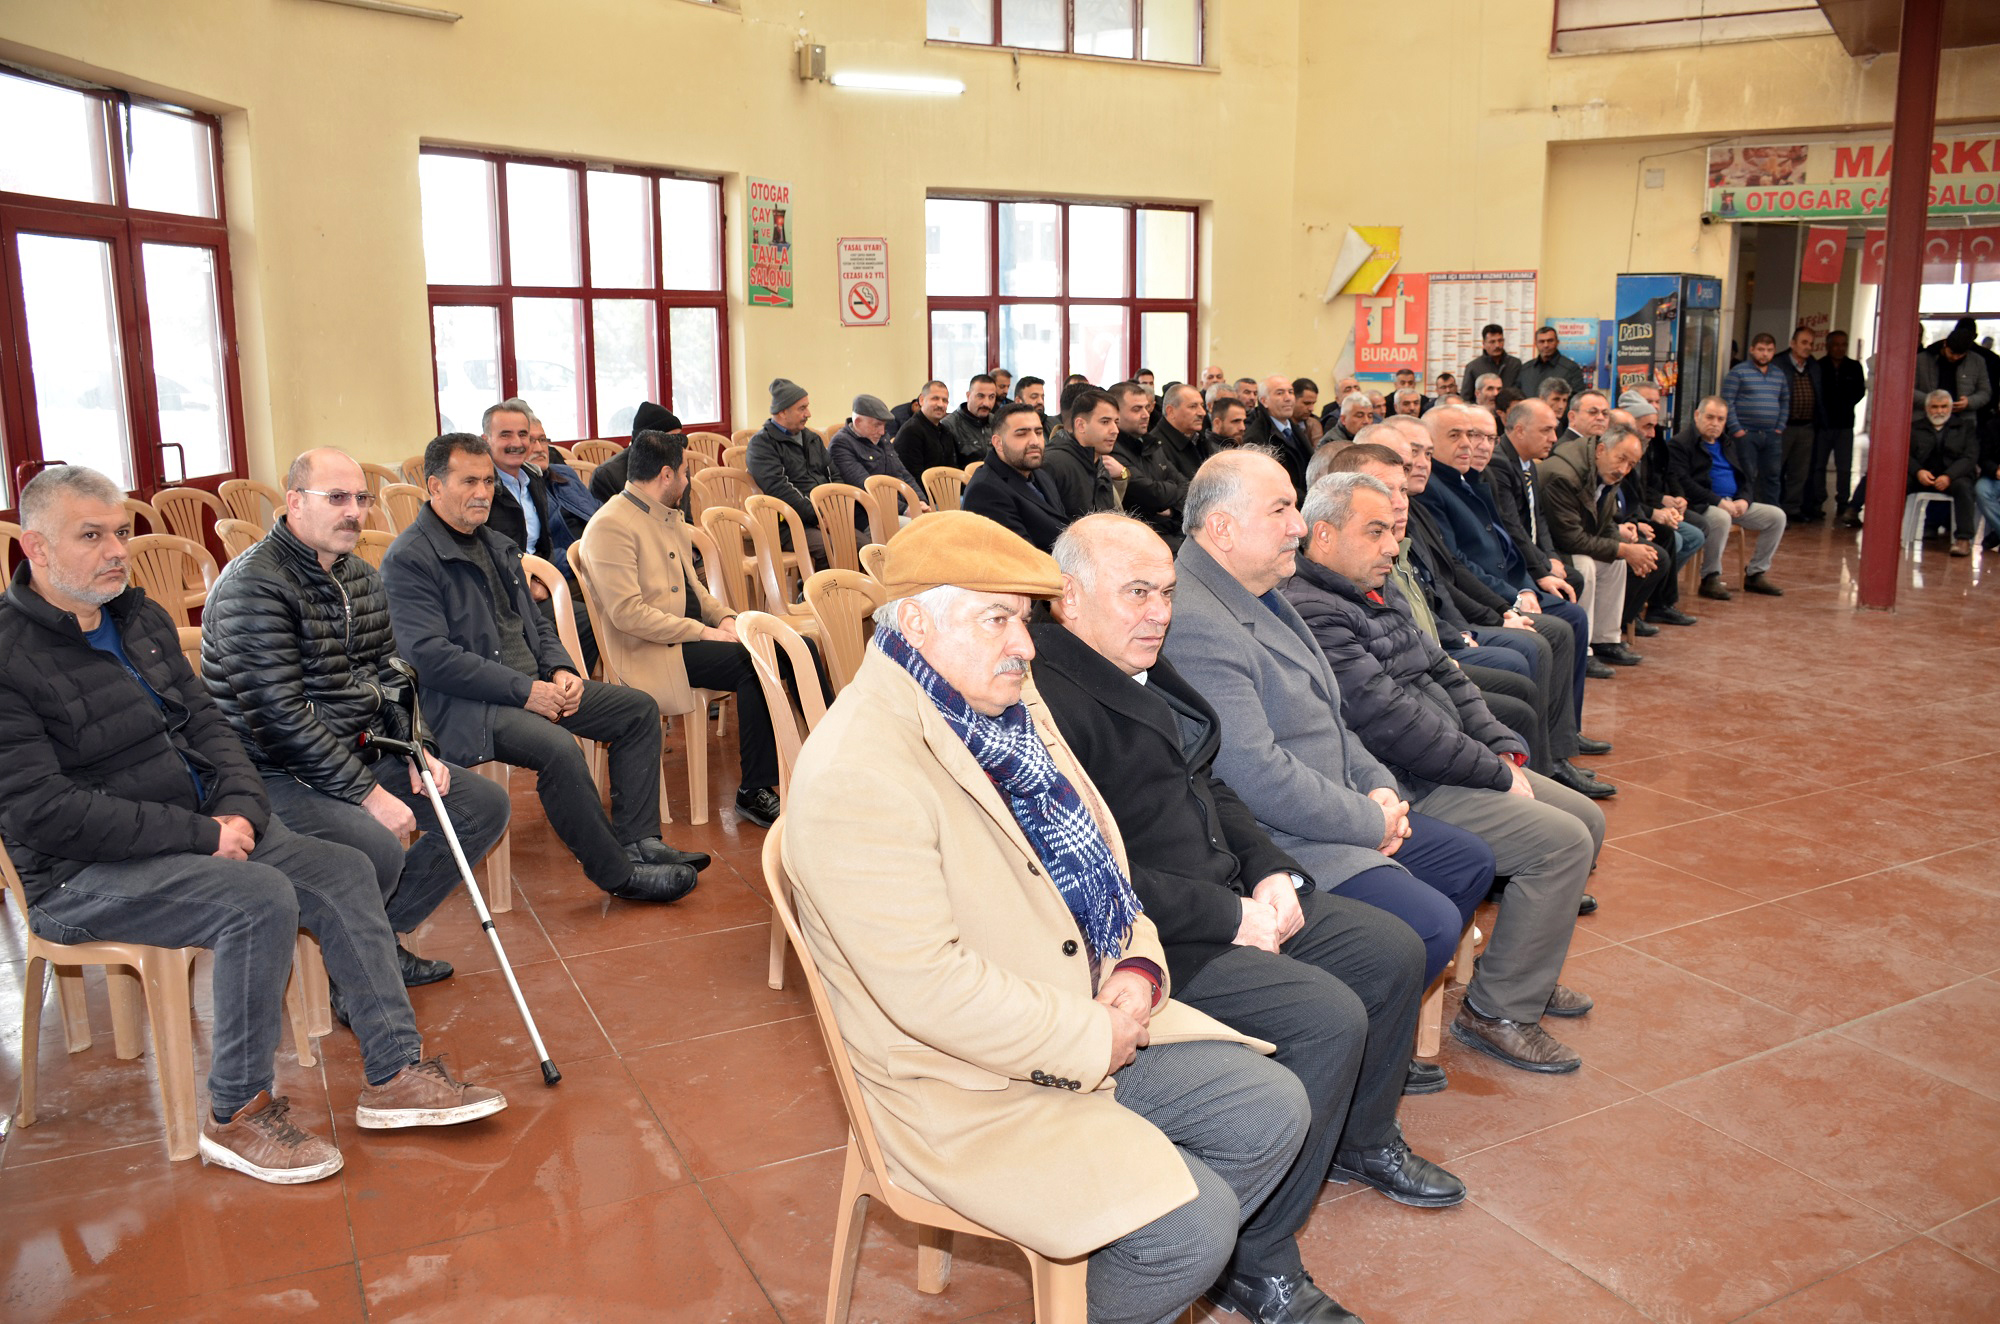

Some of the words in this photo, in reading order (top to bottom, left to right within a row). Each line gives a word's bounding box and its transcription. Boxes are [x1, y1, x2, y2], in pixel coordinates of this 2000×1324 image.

[750, 182, 790, 204] OTOGAR
[1745, 189, 1852, 212] OTOGAR
[1861, 187, 1889, 214] ÇA
[1928, 183, 2000, 206] SALO
[751, 206, 771, 226] ÇAY
[760, 228, 771, 238] VE
[751, 244, 789, 265] TAVLA
[750, 267, 792, 287] SALONU
[1361, 291, 1419, 345] TL
[1361, 347, 1419, 362] BURADA
